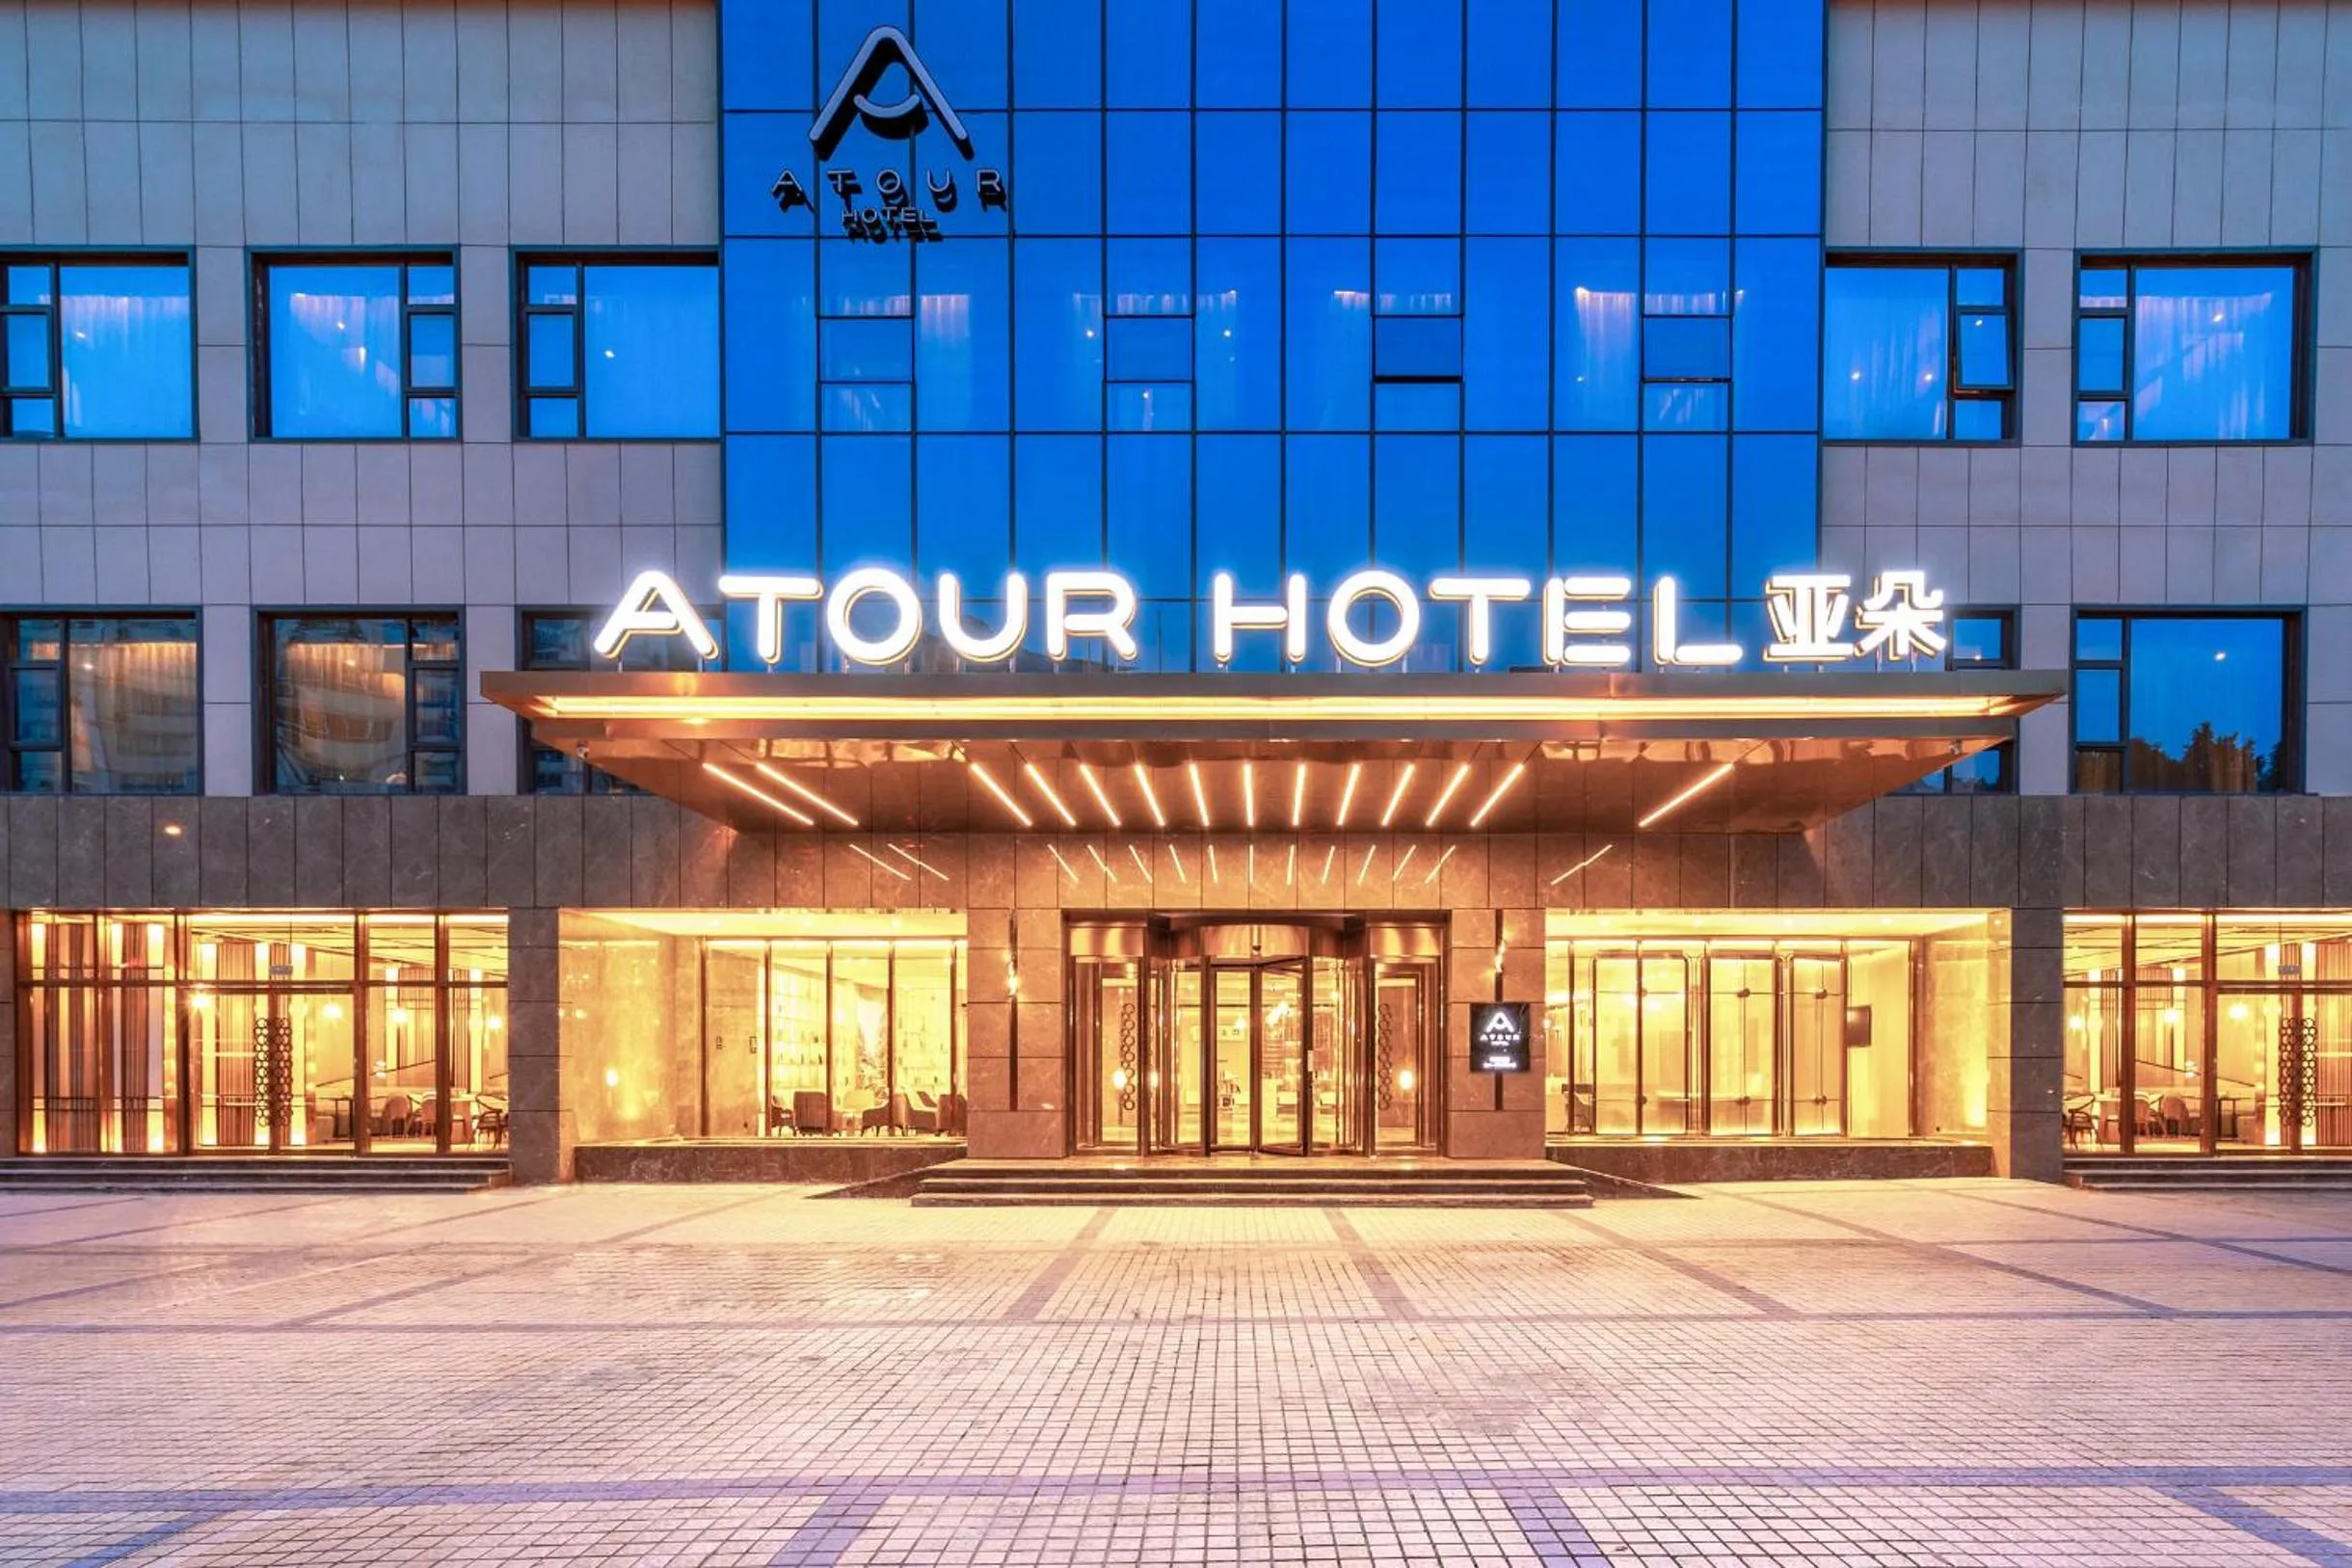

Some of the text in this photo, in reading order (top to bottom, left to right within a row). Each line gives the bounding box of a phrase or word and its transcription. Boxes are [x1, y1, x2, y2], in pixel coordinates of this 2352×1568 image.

[771, 169, 1003, 196] ATOUR
[841, 206, 935, 225] HOTEL
[593, 569, 1744, 665] ATOUR HOTEL
[1764, 571, 1948, 661] 亚朵
